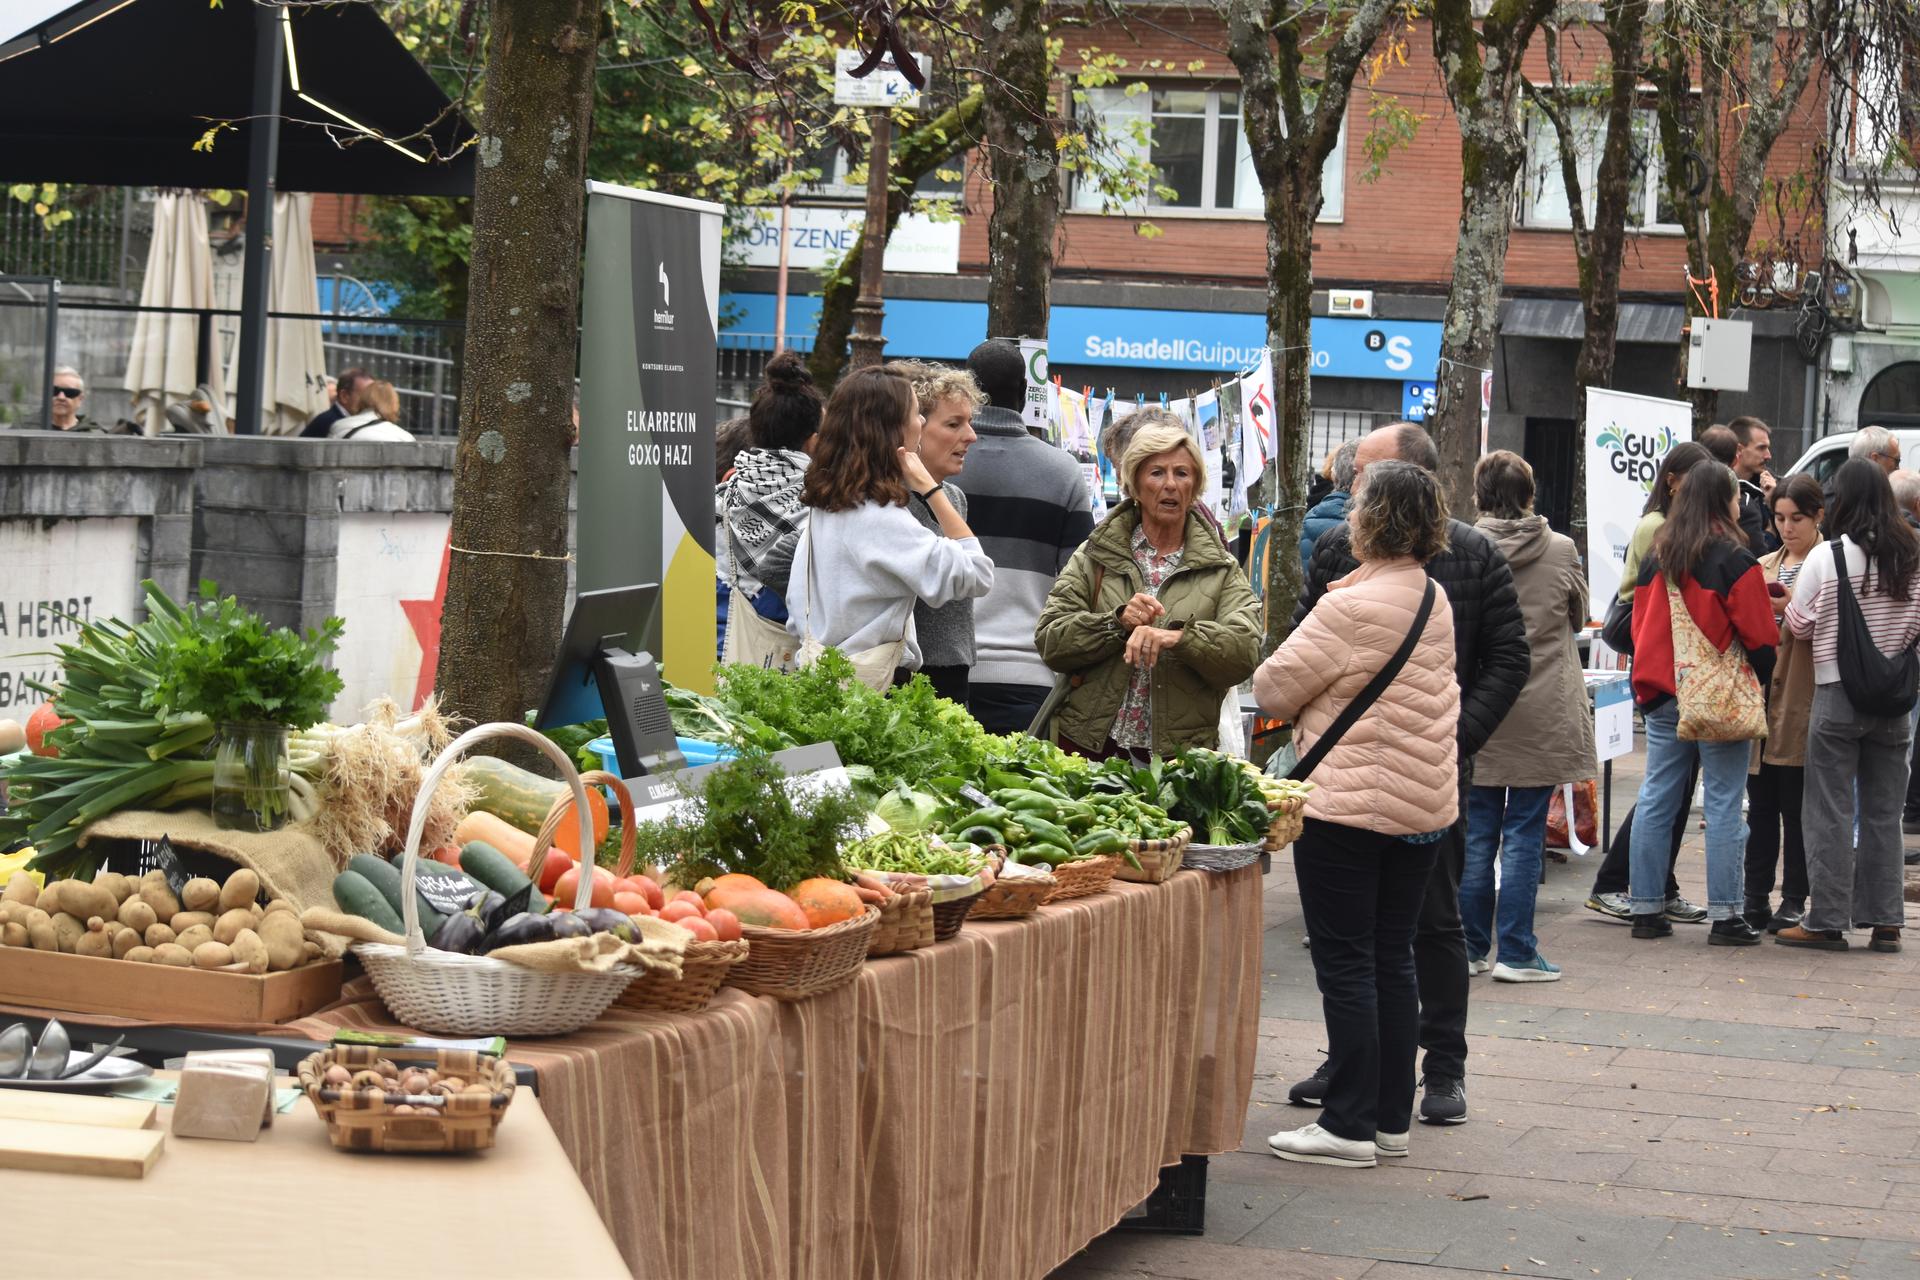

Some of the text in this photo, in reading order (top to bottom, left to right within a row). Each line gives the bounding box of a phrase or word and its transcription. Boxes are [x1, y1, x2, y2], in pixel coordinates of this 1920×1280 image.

[1384, 335, 1413, 372] S
[627, 410, 696, 433] ELKARREKIN
[628, 443, 692, 466] GOXO HAZI
[1624, 433, 1655, 459] GU
[1611, 450, 1662, 483] GEO
